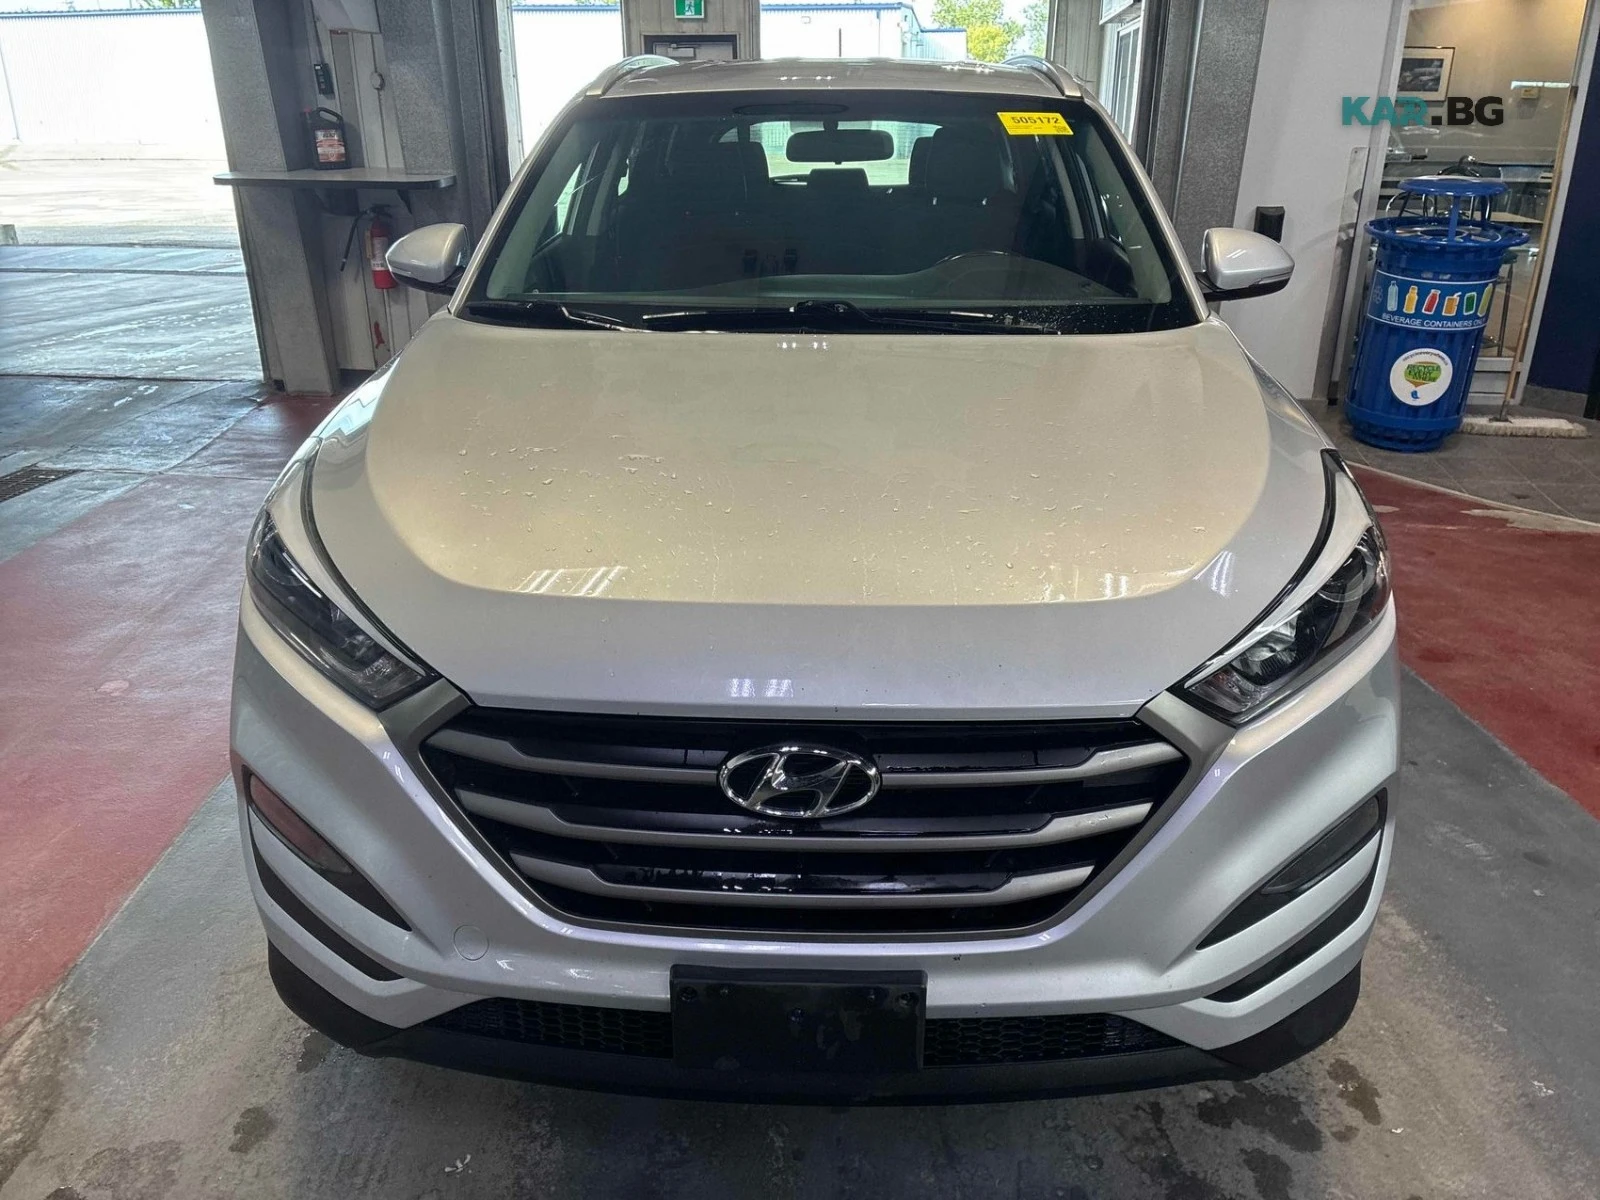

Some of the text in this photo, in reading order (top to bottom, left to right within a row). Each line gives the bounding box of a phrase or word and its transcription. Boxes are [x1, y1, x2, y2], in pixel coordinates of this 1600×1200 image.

[1011, 116, 1060, 124] 505172
[1381, 312, 1422, 326] BEVERAGE
[1424, 319, 1473, 328] CONTAINERS
[1407, 363, 1441, 372] RECYCLE
